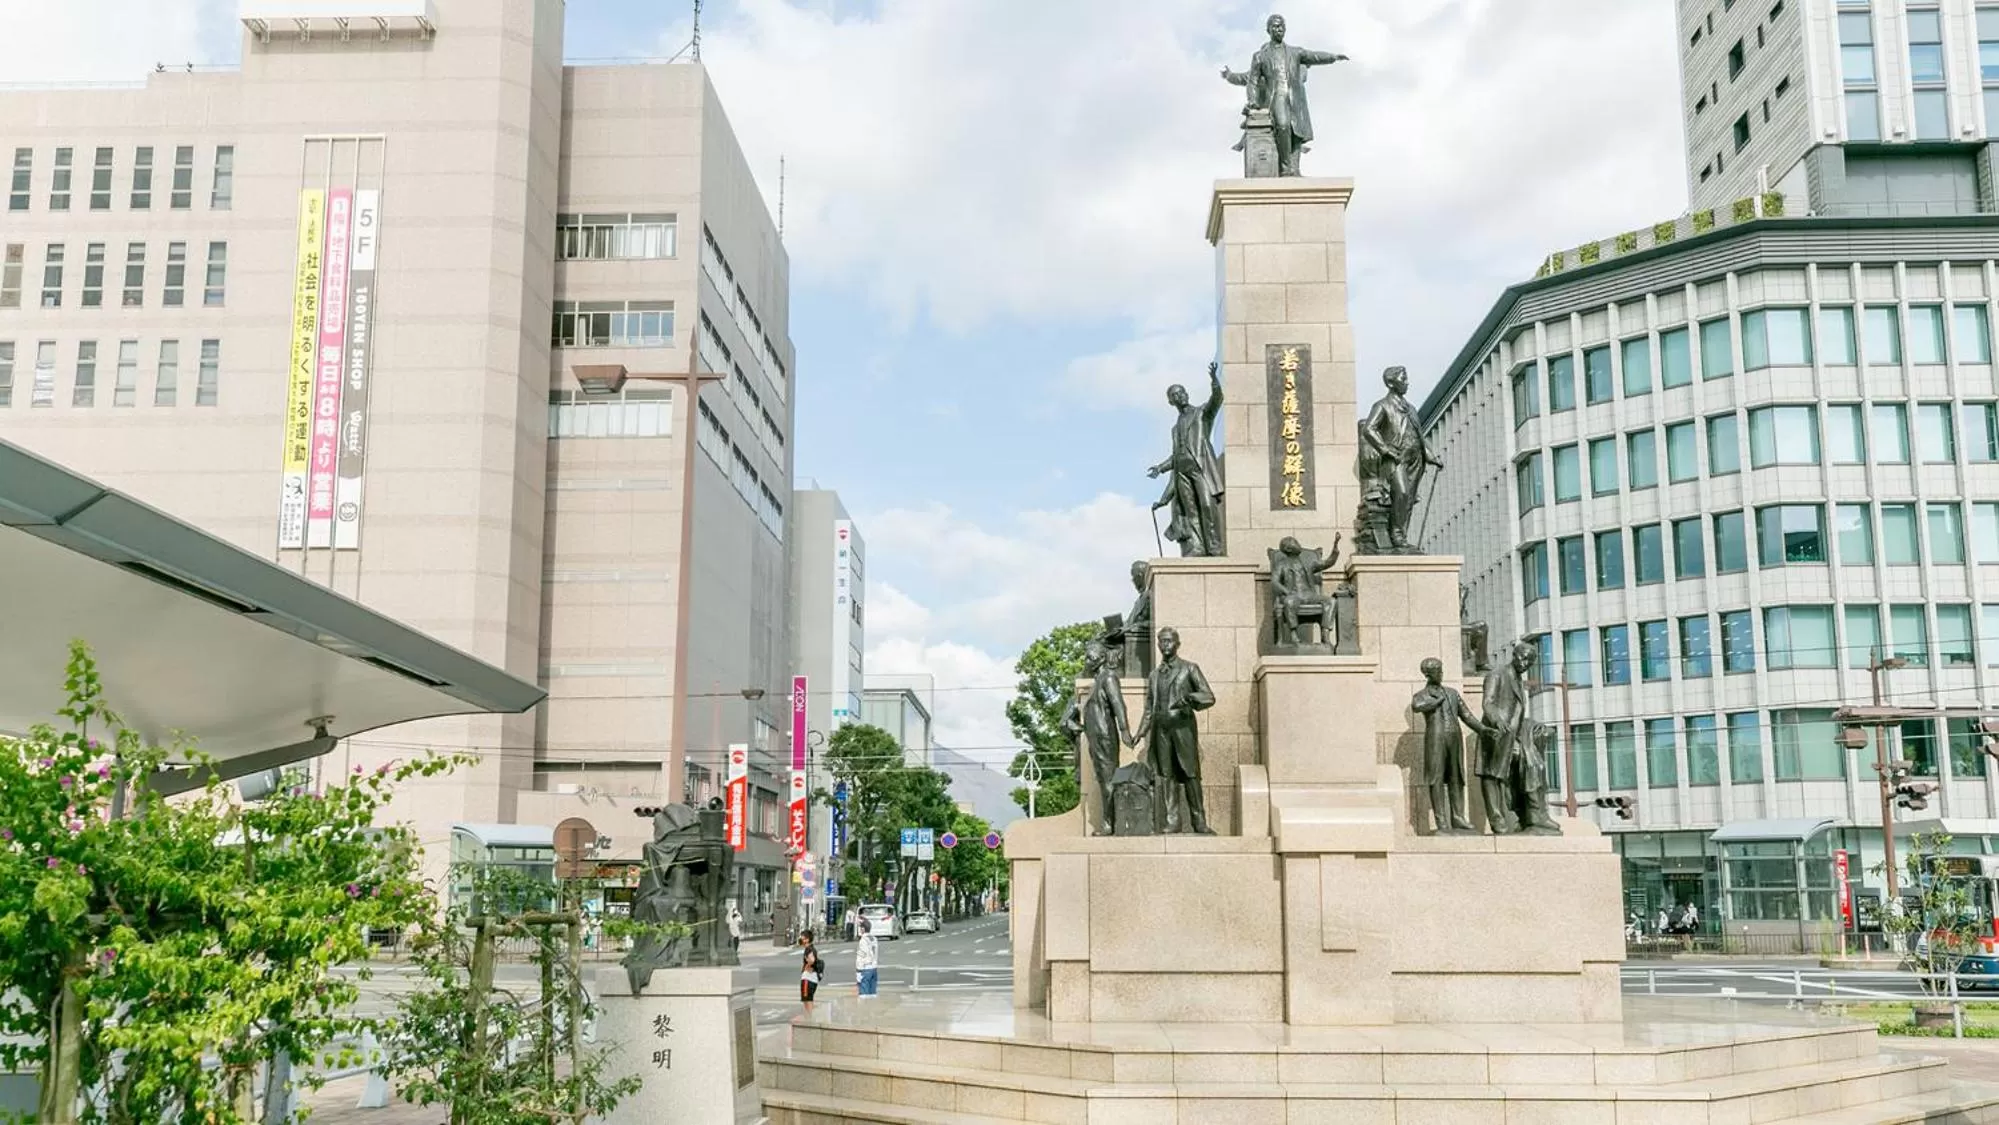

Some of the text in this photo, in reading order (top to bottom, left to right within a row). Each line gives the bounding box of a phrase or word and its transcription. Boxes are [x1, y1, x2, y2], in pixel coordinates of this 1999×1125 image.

[294, 251, 319, 462] 社会を明るくする運動
[350, 286, 368, 391] 100YEN SHOP
[652, 1014, 674, 1069] 黎明
